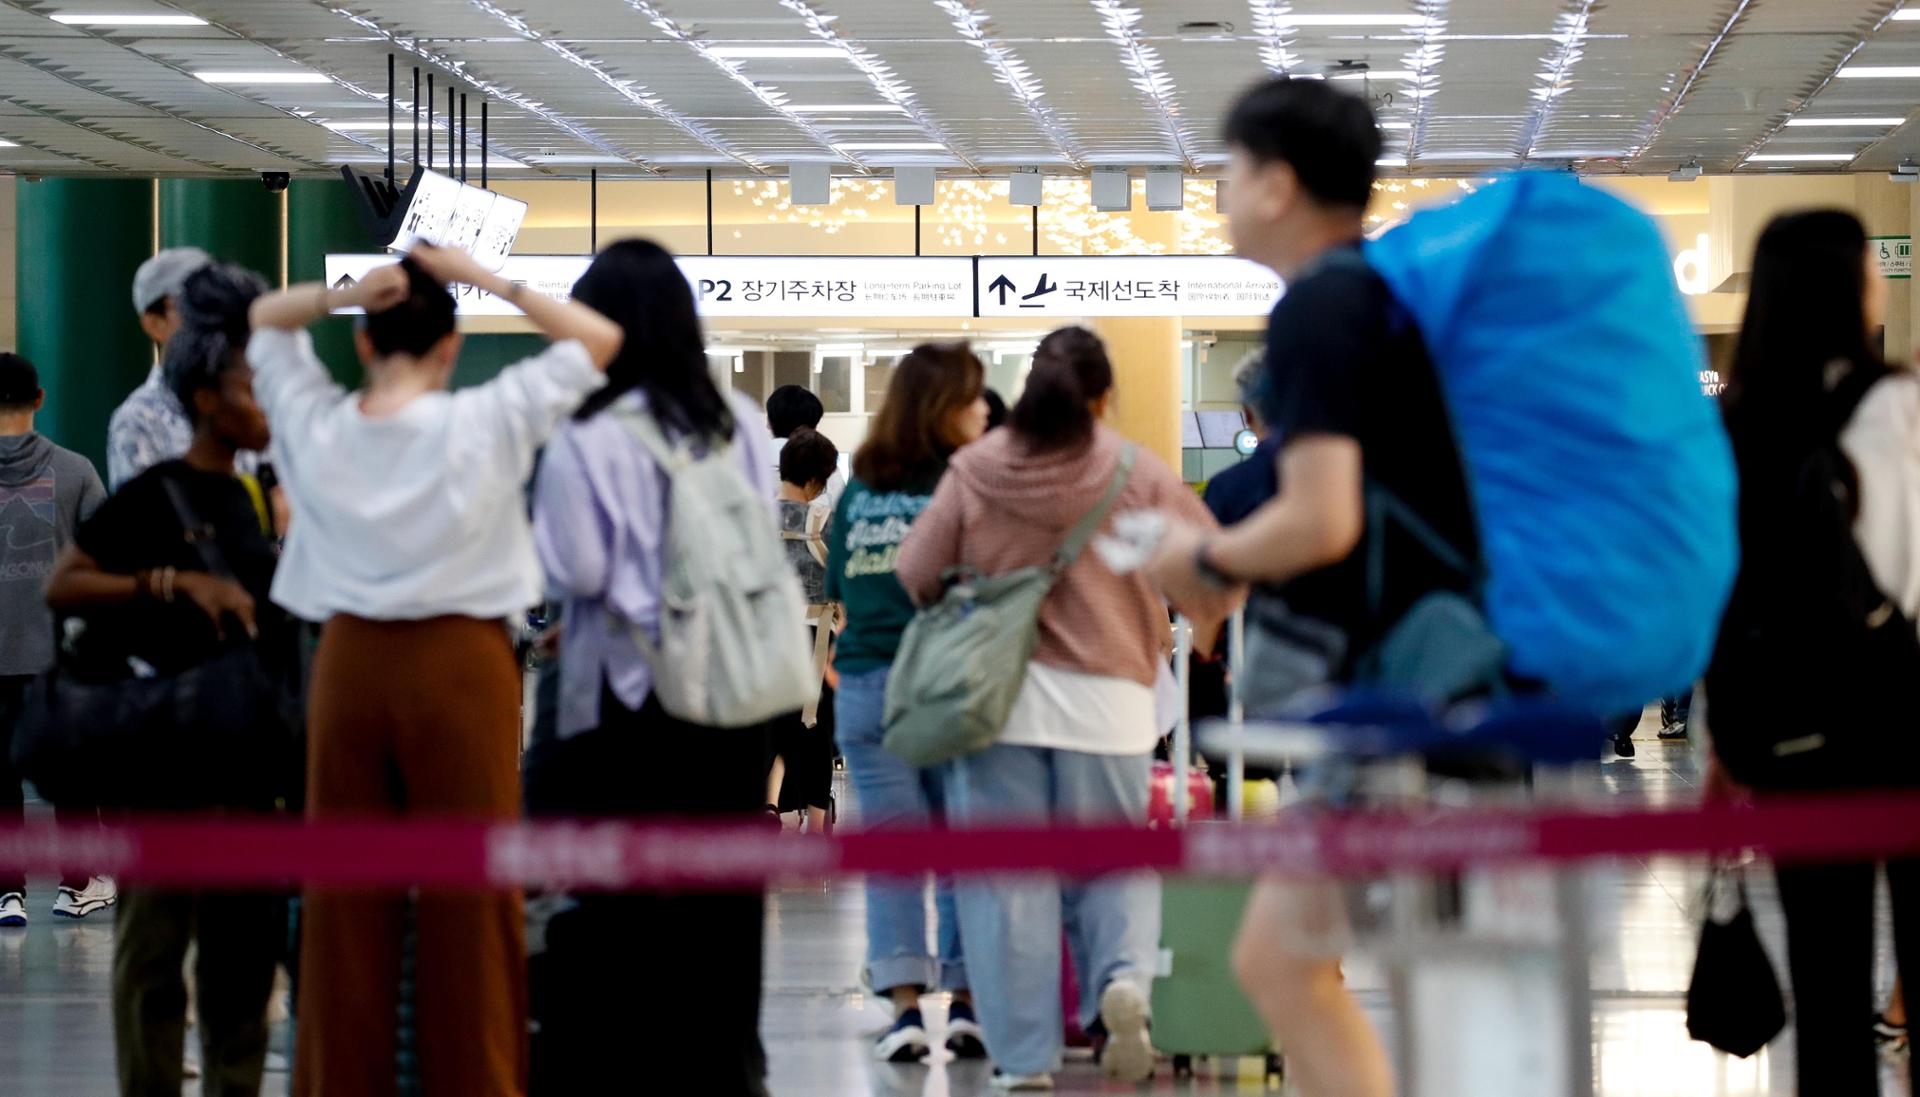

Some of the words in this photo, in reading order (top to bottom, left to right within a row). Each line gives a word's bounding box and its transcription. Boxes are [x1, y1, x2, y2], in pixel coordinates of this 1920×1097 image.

[538, 281, 570, 289] Rental
[699, 279, 732, 301] P2
[742, 280, 857, 301] 장기주차장
[913, 281, 945, 291] Parking
[948, 281, 962, 289] Lot
[1187, 281, 1242, 290] International
[1245, 281, 1279, 290] Arrivals
[1064, 280, 1180, 301] 국제선도착
